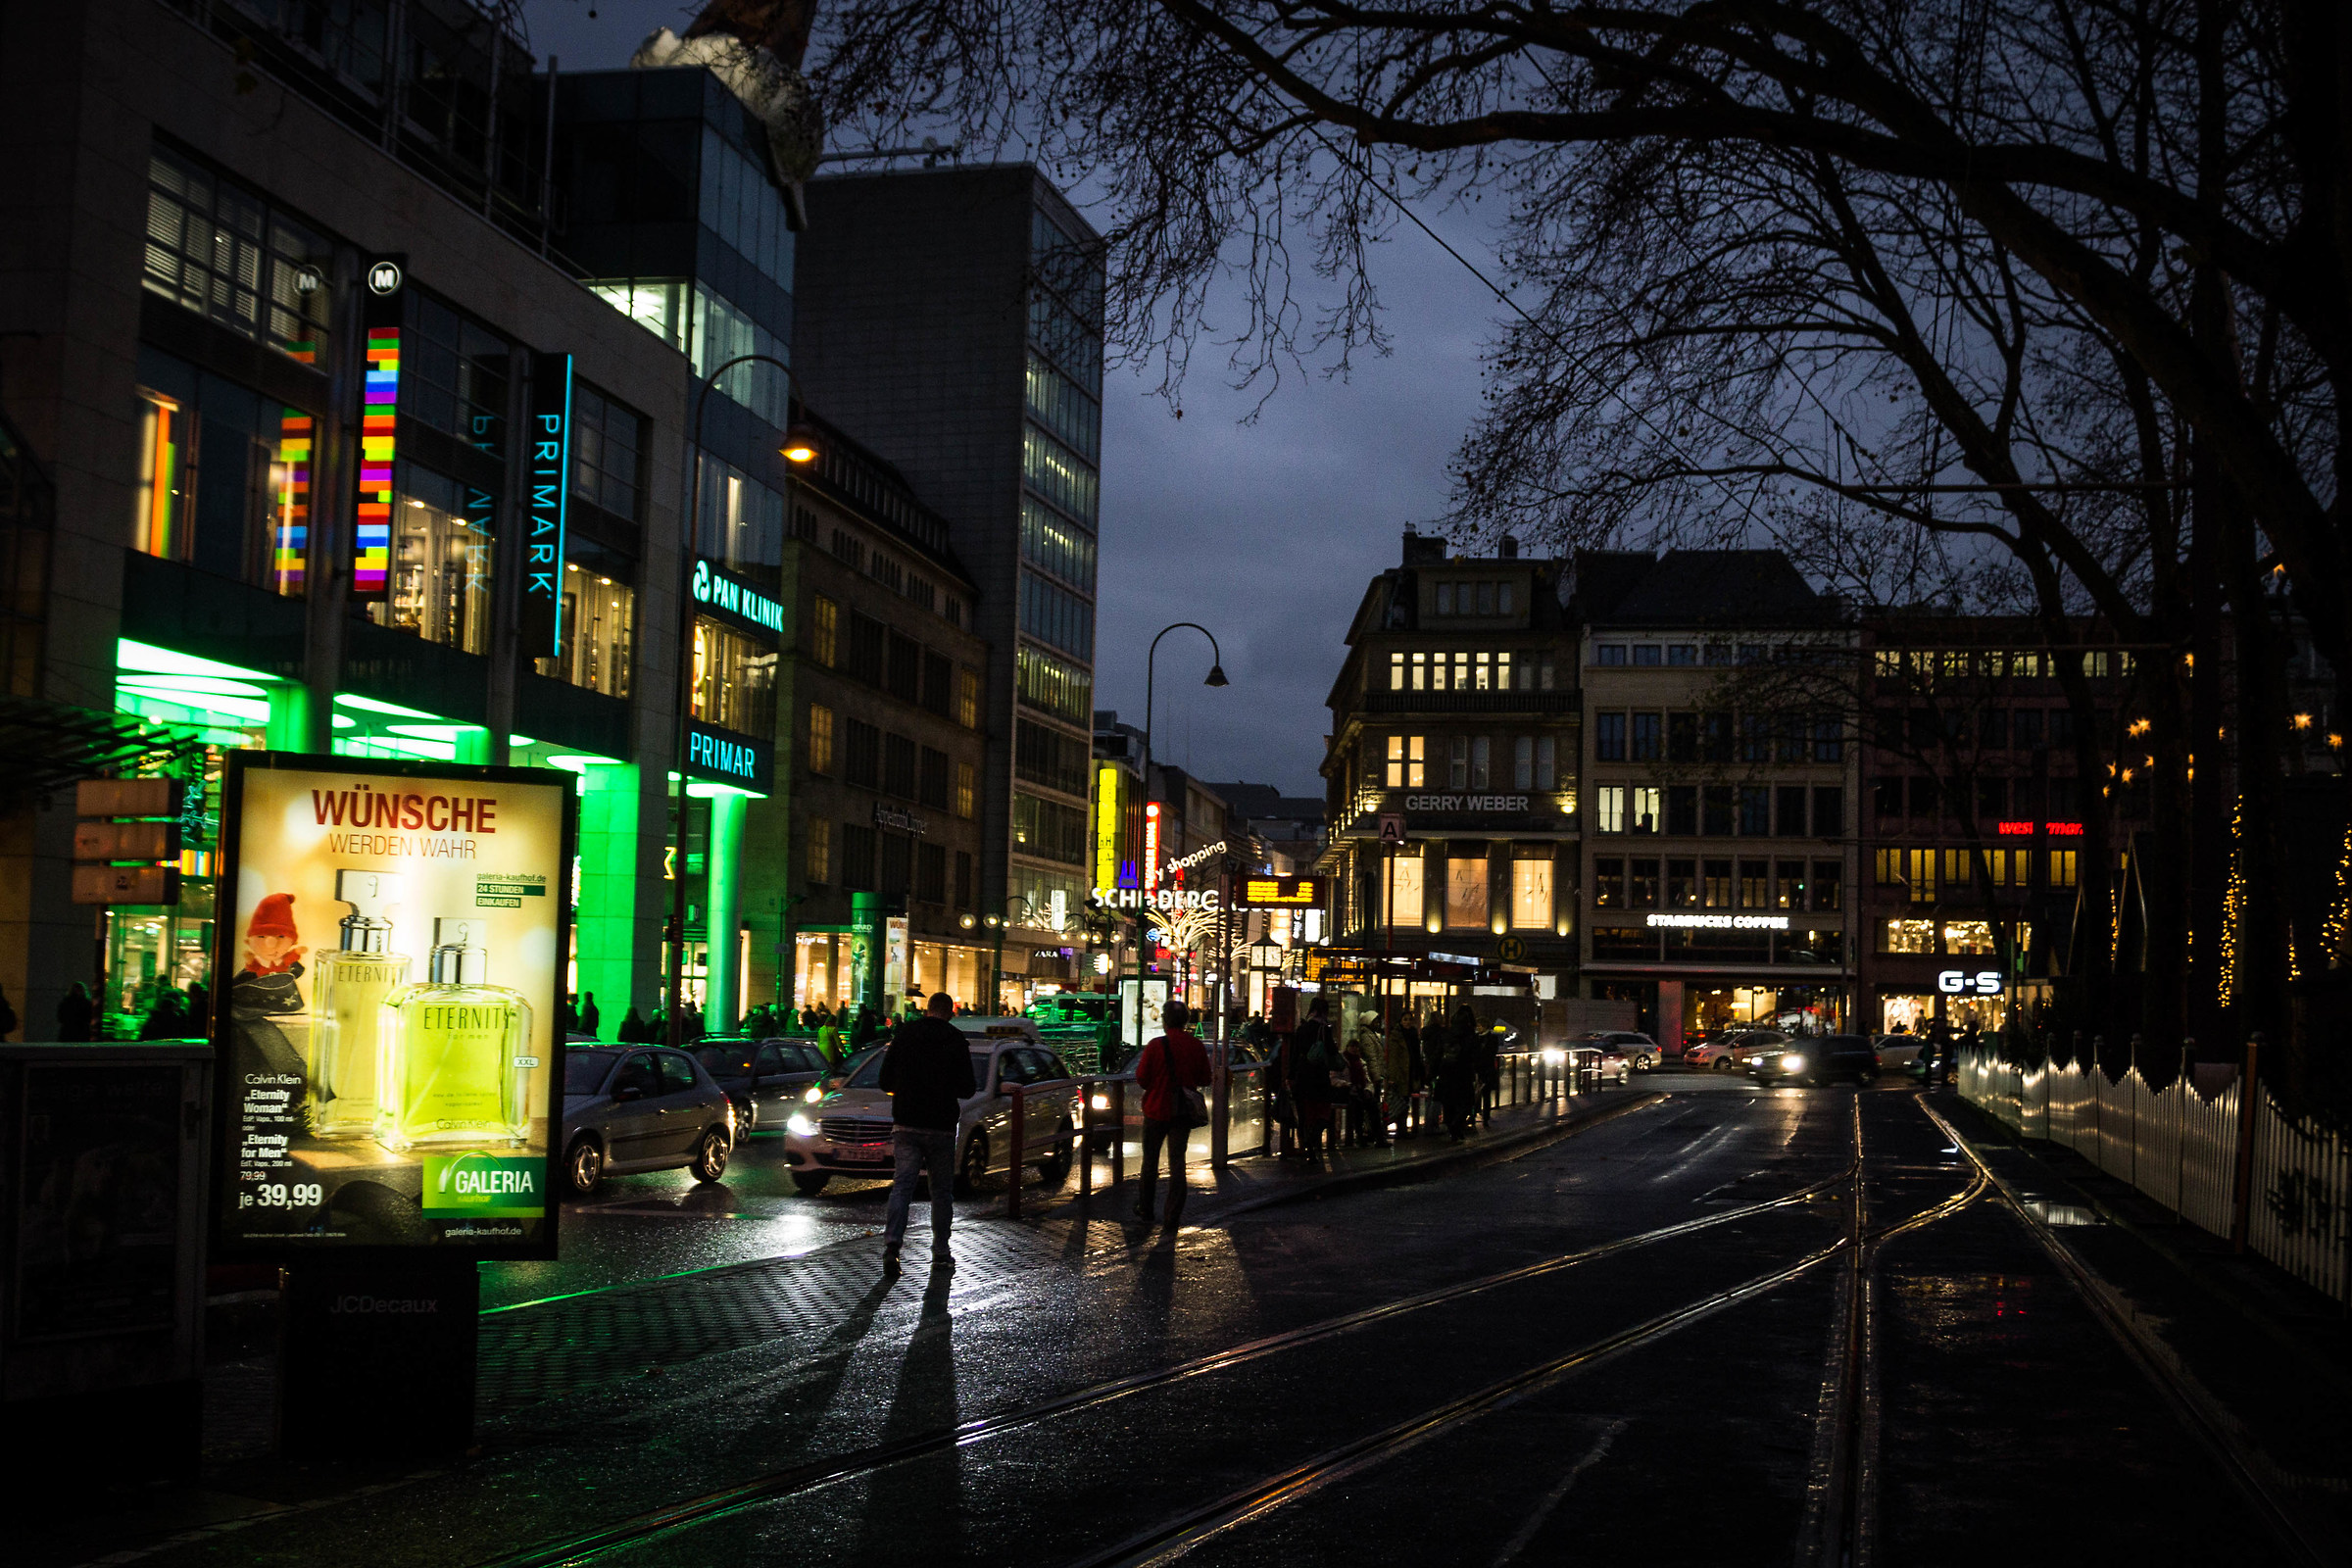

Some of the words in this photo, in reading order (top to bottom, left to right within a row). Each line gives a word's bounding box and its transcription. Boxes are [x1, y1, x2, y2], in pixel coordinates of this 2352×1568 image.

[529, 414, 563, 593] PRIMARK
[712, 575, 740, 613] PAN
[742, 588, 784, 633] KLINIK
[312, 784, 496, 833] WÜNSCHE
[1405, 795, 1464, 811] GERRY
[1467, 795, 1529, 811] WEBER
[1382, 821, 1397, 838] A
[329, 833, 413, 856] WERDEN
[420, 838, 476, 859] WAHR
[1166, 840, 1227, 874] shopping
[477, 872, 547, 883] galeria-kaufhof.de
[490, 885, 524, 894] STUNDEN
[1734, 915, 1788, 929] COFFEE
[423, 1006, 512, 1030] ETERNITY
[516, 1057, 535, 1066] XXL
[245, 1073, 277, 1085] Calvin
[277, 1074, 302, 1085] Klein
[241, 1148, 257, 1158] for
[455, 1170, 534, 1194] GALERIA
[238, 1192, 254, 1209] je
[257, 1183, 323, 1211] 39,99
[445, 1227, 522, 1238] galeria-kaufhof.de
[330, 1295, 439, 1314] JCDecaux
